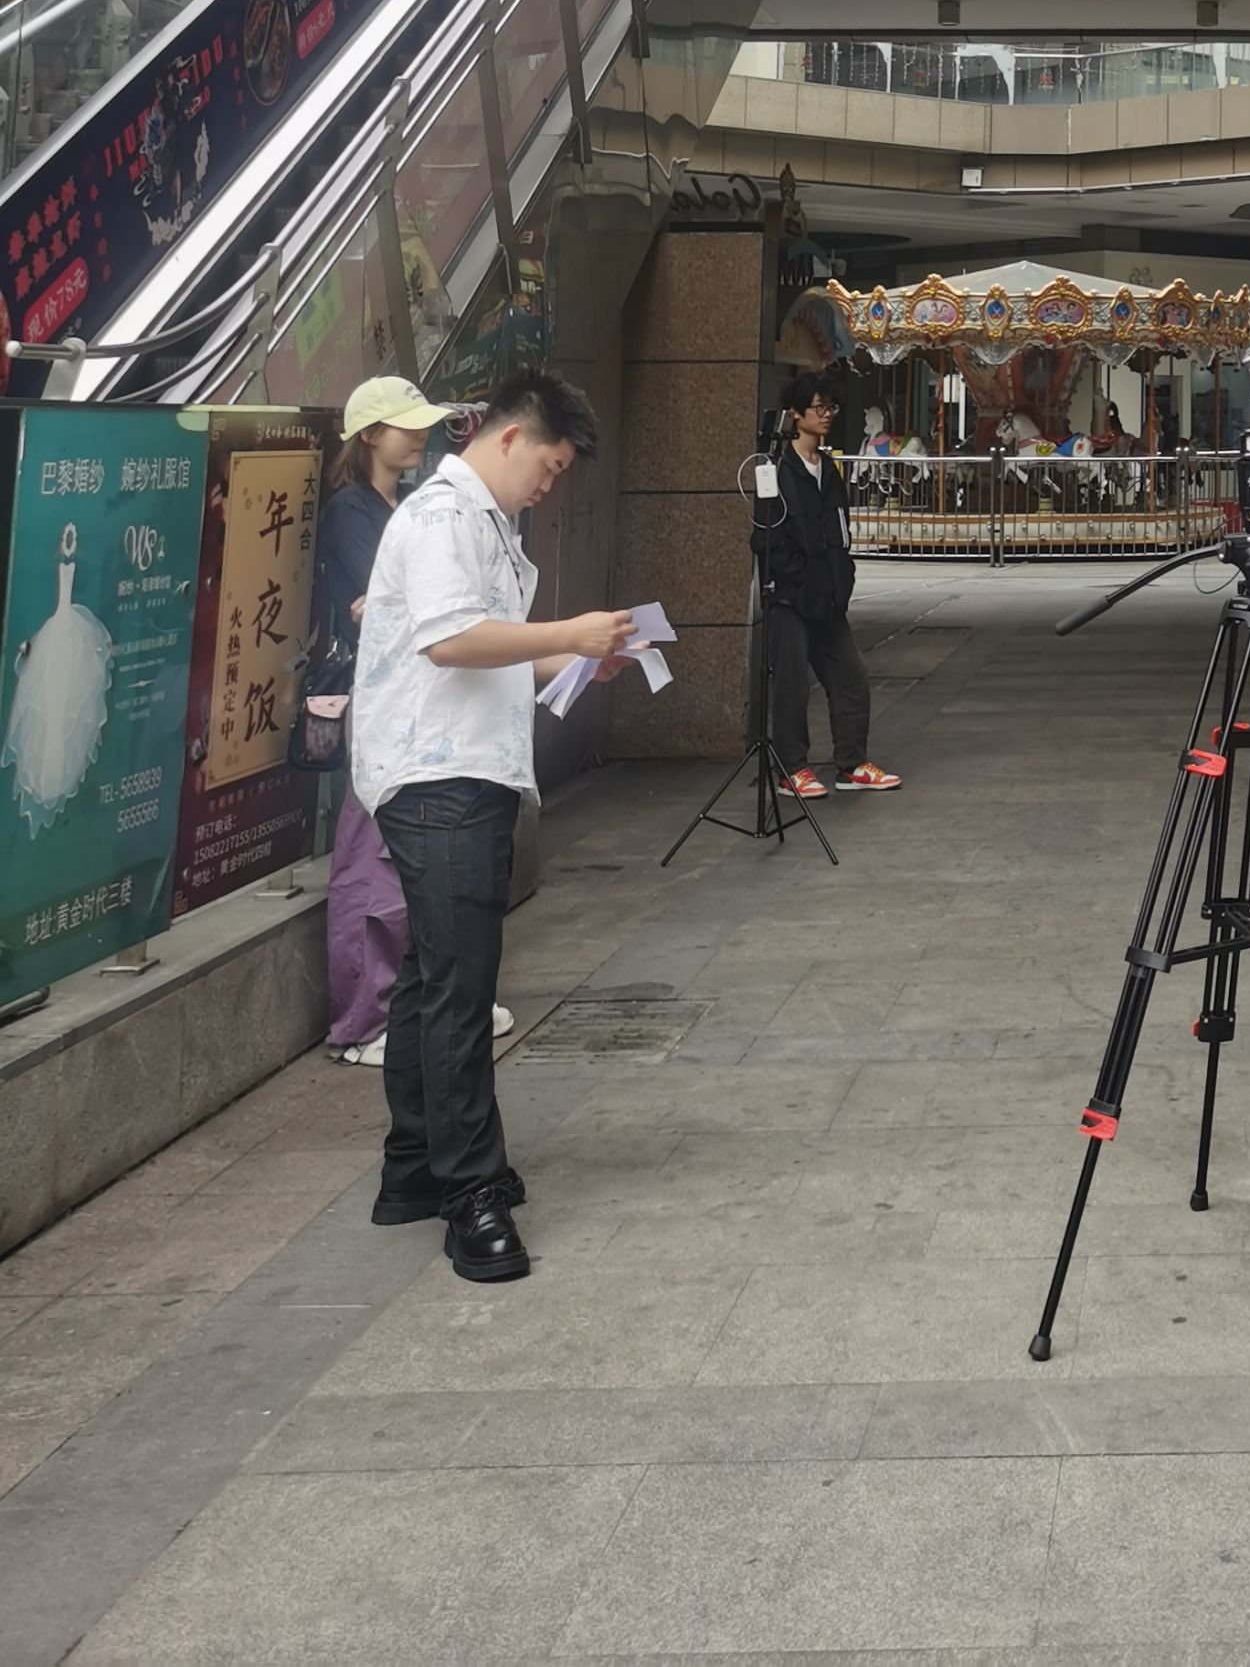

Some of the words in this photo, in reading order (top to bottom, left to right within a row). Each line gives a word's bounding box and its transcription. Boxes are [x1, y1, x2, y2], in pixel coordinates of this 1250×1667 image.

[41, 459, 104, 495] 巴黎婚纱
[300, 471, 316, 551] 大四合
[244, 490, 294, 743] 年夜饭
[220, 605, 243, 741] 火热预定中
[25, 875, 134, 945] 地址:黄金时代三楼
